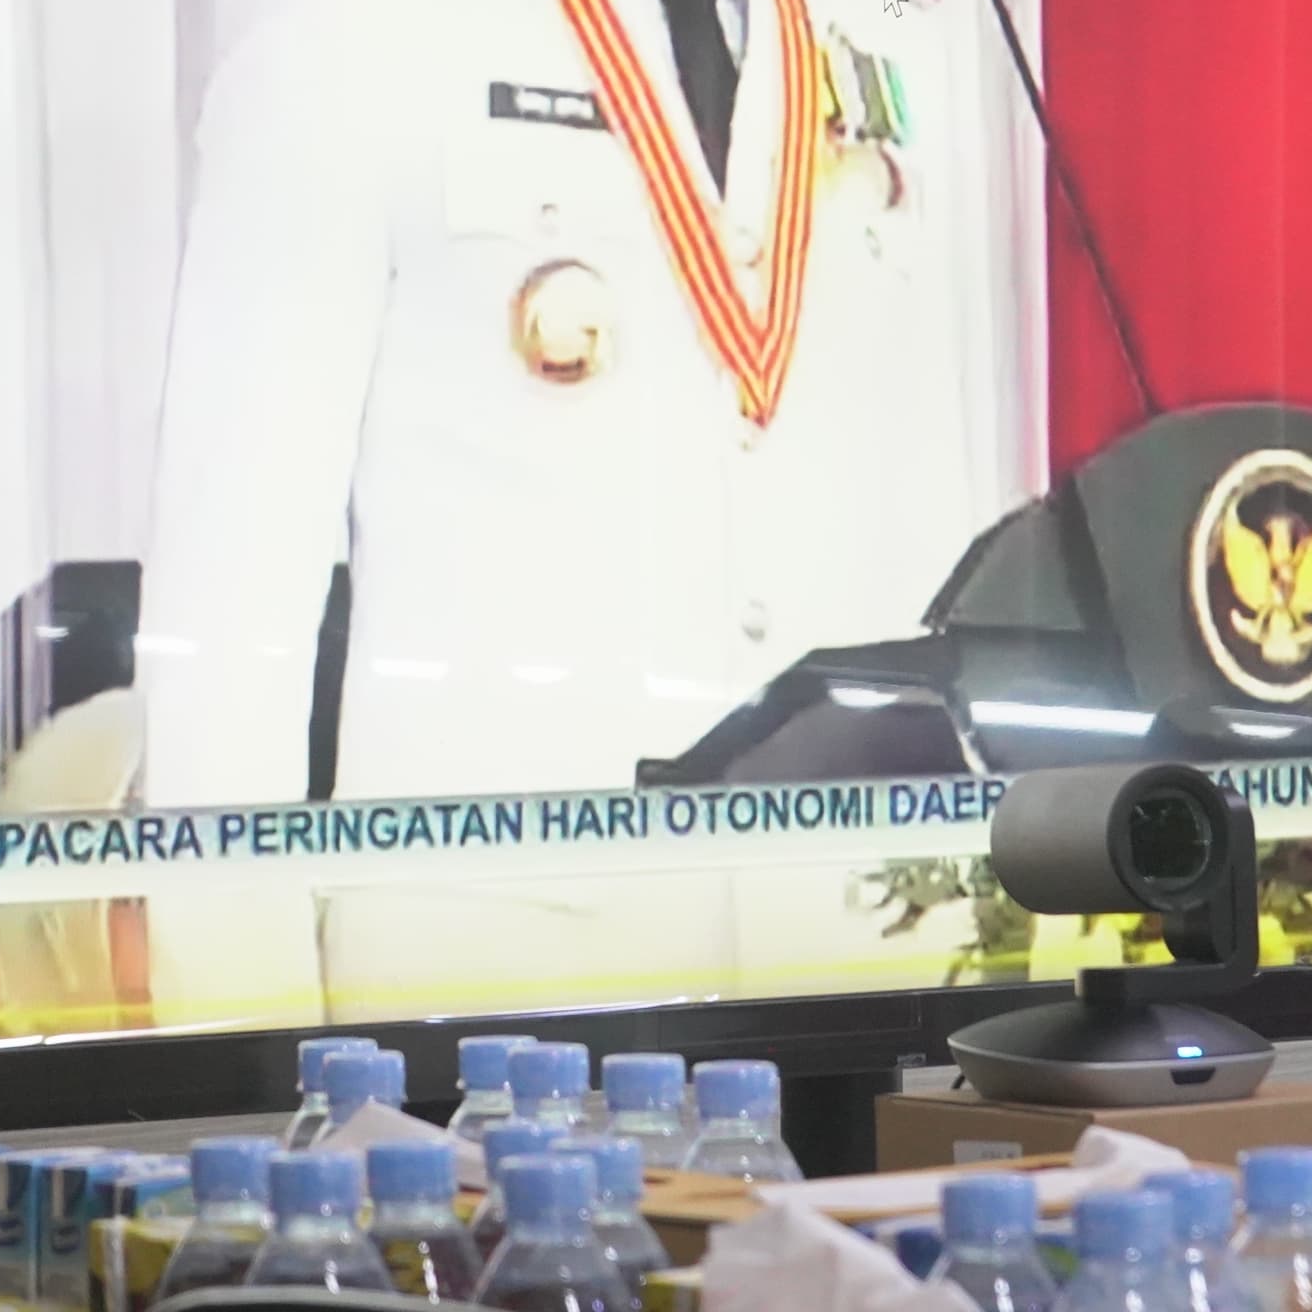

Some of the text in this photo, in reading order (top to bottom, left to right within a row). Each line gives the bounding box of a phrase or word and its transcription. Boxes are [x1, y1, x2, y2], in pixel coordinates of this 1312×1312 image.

[218, 801, 525, 859] PERINGATAN
[540, 794, 650, 842] HARI
[663, 784, 875, 836] OTONOMI
